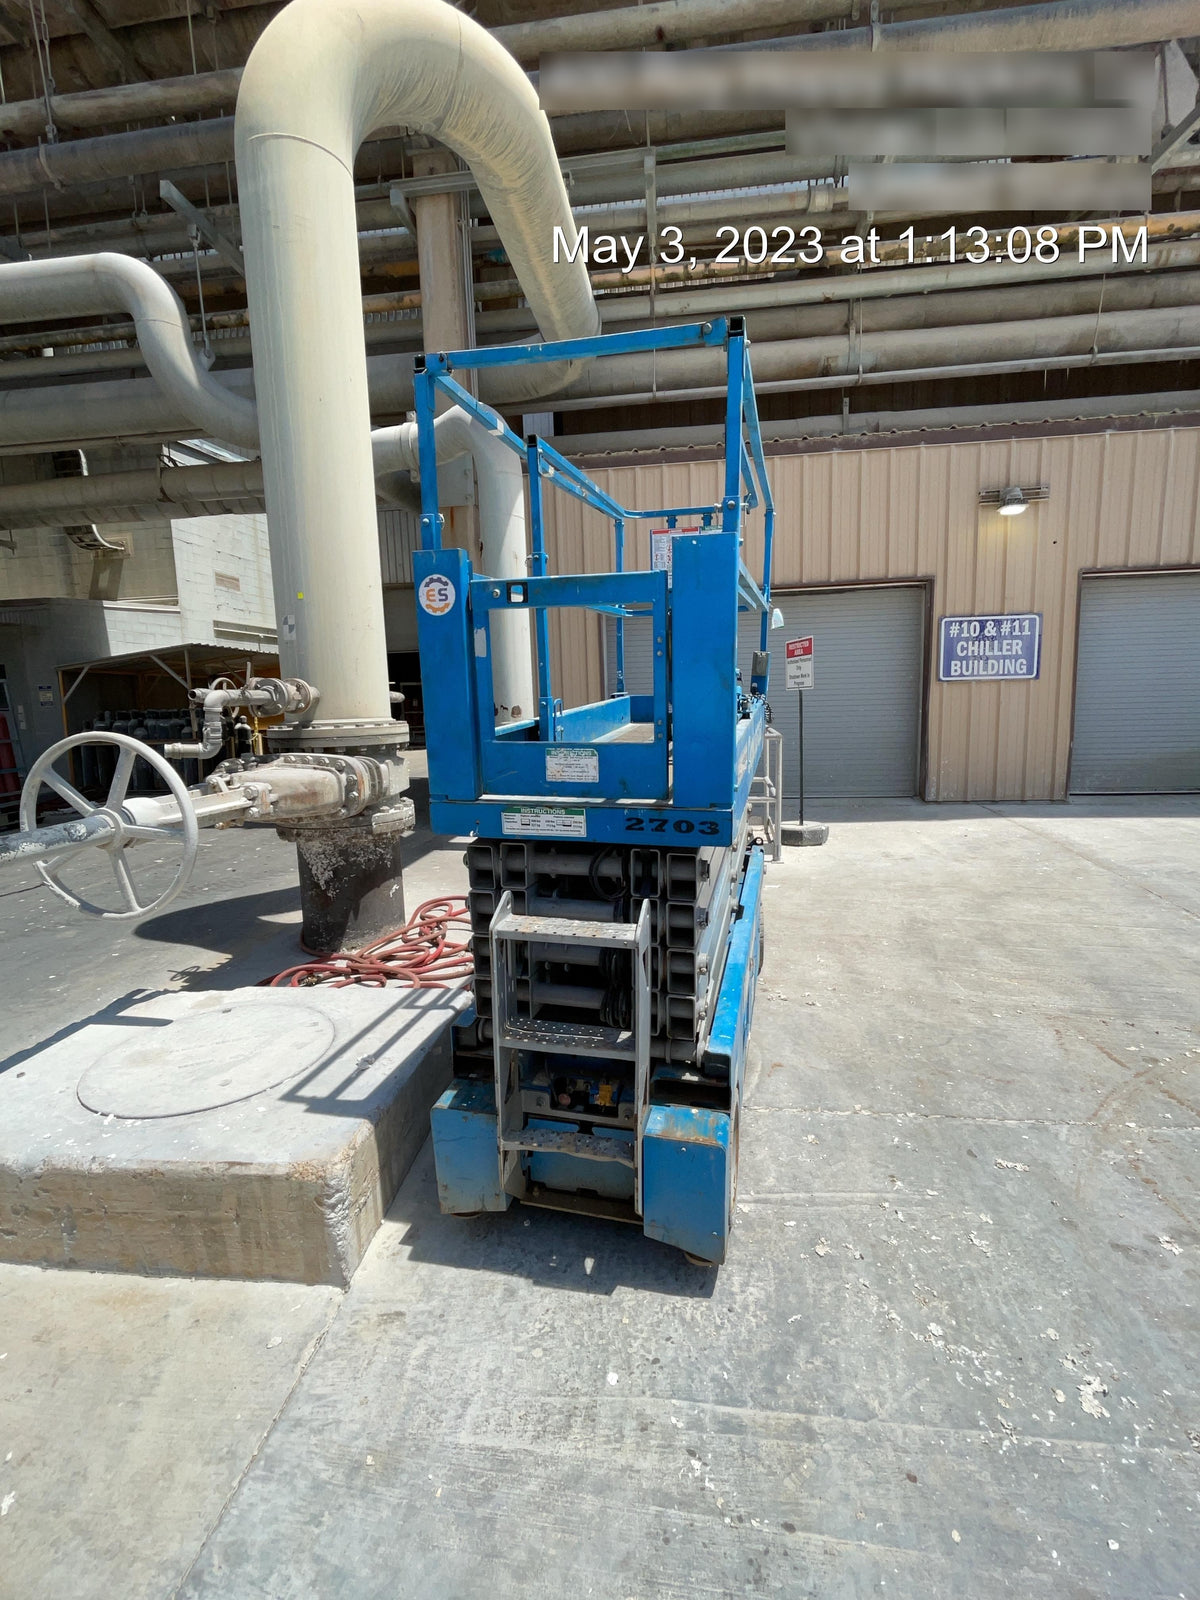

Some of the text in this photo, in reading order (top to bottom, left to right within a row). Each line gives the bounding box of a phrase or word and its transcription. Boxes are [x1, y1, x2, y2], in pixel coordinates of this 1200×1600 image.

[425, 588, 449, 602] ES
[949, 620, 1031, 638] #10 & #11
[788, 640, 809, 650] RESTRICTED
[793, 648, 804, 656] AREA
[956, 640, 1023, 657] CHILLER
[950, 659, 1027, 676] BUILDING
[625, 817, 720, 836] 2703
